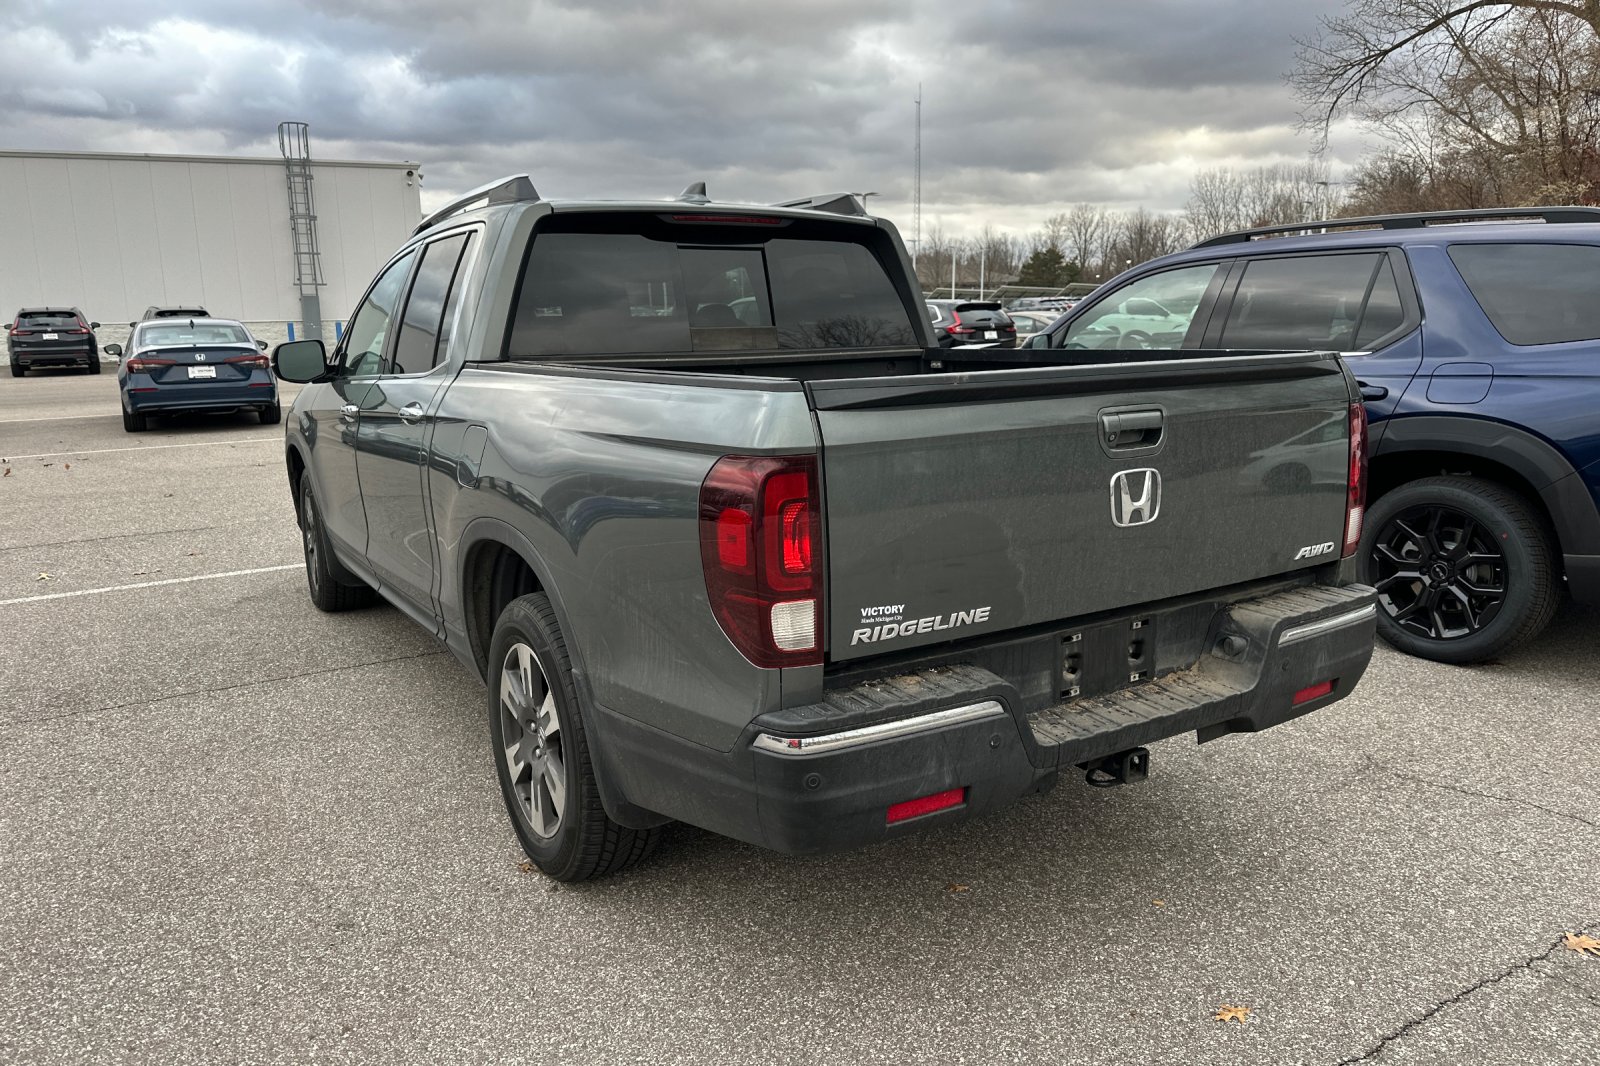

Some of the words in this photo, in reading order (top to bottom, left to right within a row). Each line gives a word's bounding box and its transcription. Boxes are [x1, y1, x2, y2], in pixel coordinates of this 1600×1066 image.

[1293, 541, 1335, 560] AWD
[860, 604, 905, 616] VICTORY
[850, 606, 992, 646] RIDGELINE
